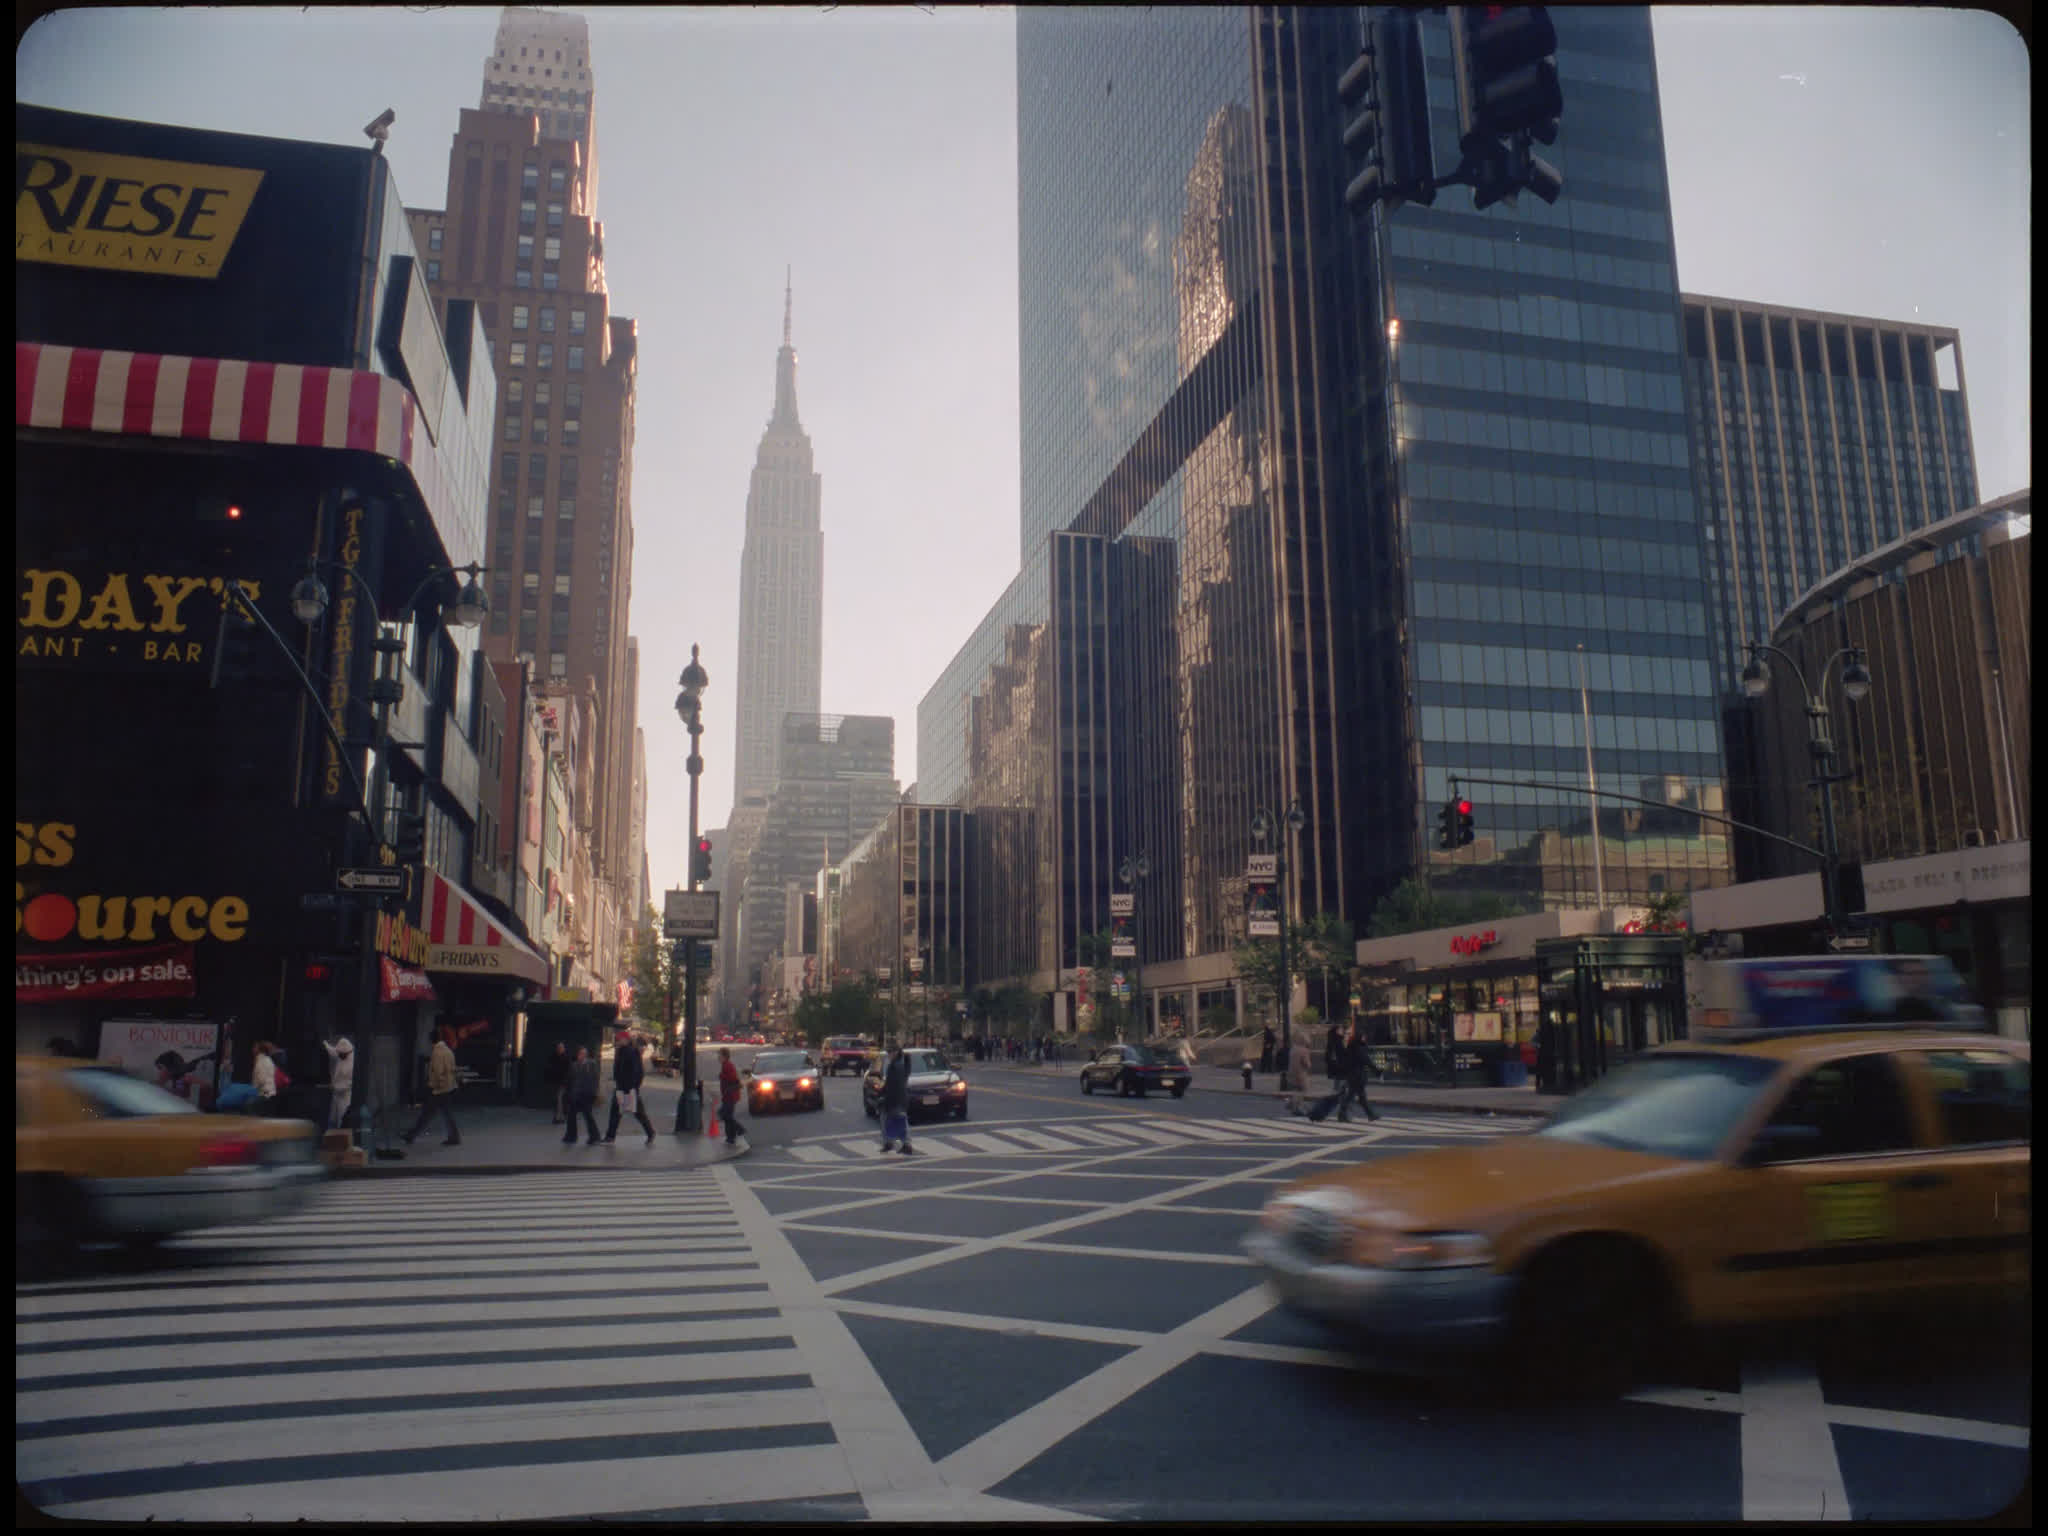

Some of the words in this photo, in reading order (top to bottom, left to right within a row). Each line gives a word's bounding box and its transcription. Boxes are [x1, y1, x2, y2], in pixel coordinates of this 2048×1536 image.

[17, 153, 230, 242] RIESE
[19, 635, 84, 657] ANT
[144, 641, 203, 663] BAR
[1250, 863, 1273, 871] NYC
[16, 880, 250, 942] ource
[103, 967, 134, 982] on
[140, 959, 192, 982] sale.
